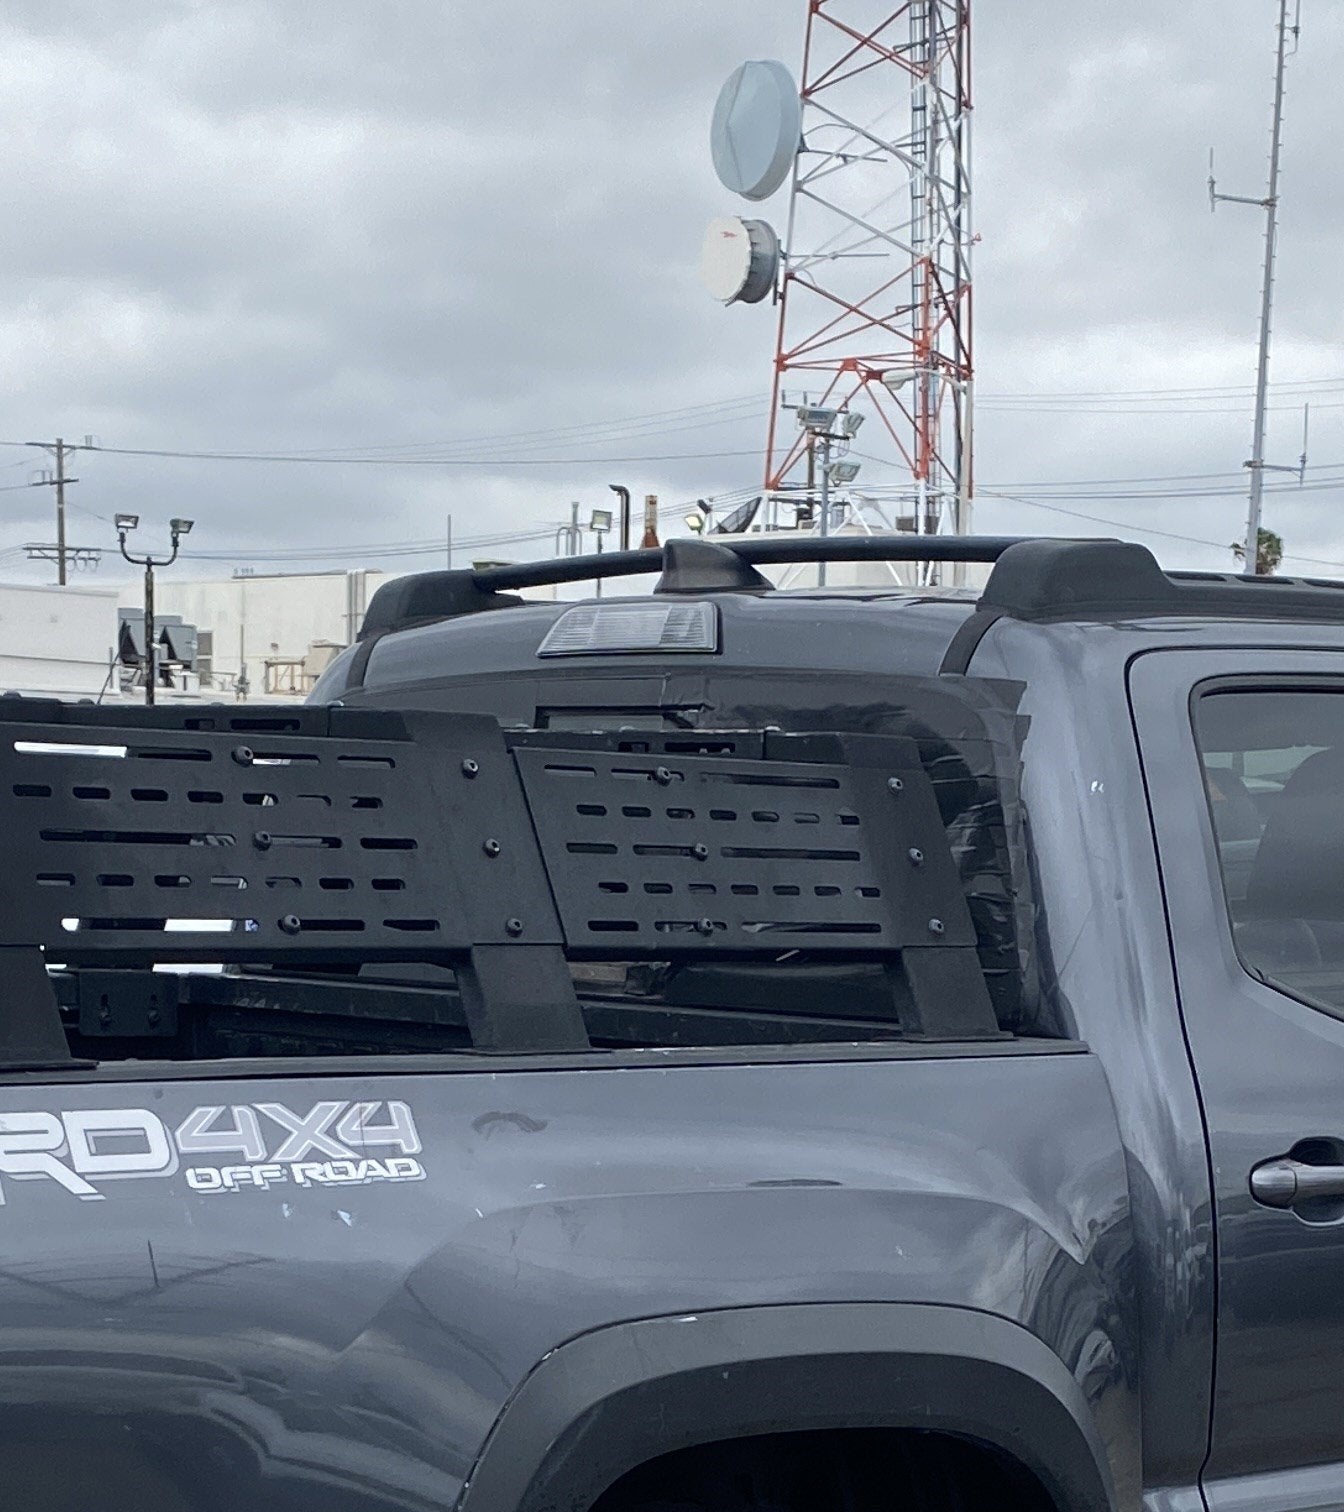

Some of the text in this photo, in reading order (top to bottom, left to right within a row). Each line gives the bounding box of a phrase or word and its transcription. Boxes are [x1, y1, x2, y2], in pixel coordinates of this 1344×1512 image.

[174, 1100, 424, 1163] 4X4
[185, 1156, 427, 1195] OFF ROAD
